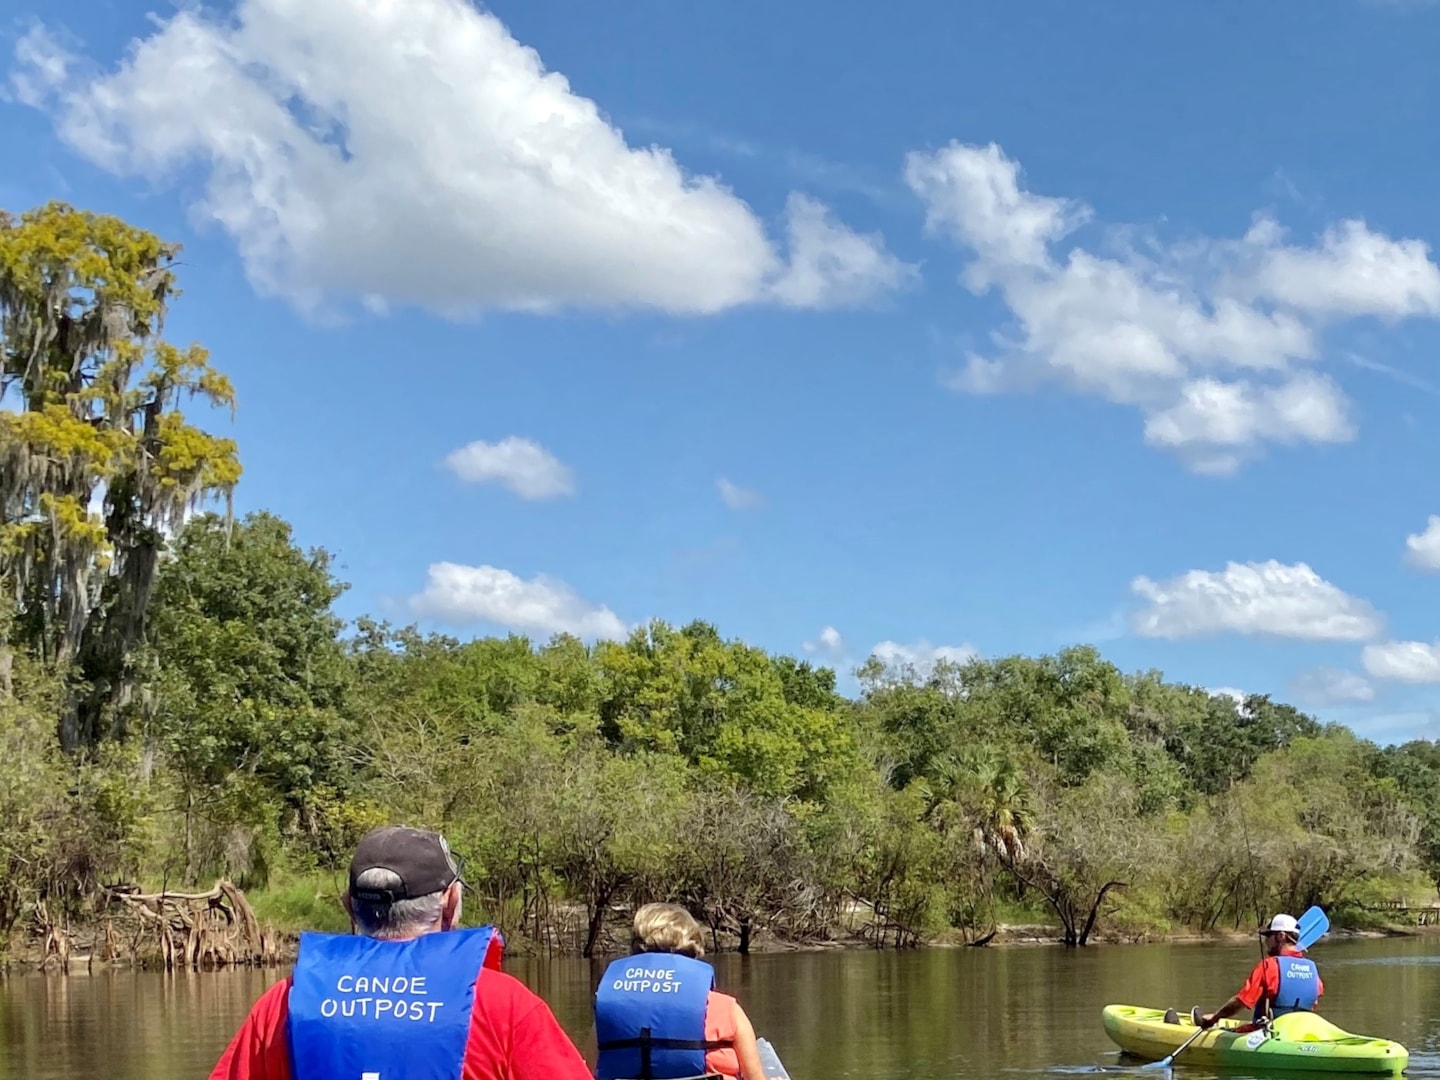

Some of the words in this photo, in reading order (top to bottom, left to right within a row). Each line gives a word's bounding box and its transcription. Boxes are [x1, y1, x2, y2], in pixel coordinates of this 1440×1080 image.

[625, 968, 675, 980] CANOE
[1287, 971, 1313, 979] OUTPOST
[337, 975, 428, 994] CANOE
[613, 980, 682, 993] OUTPOST
[320, 998, 444, 1022] OUTPOST
